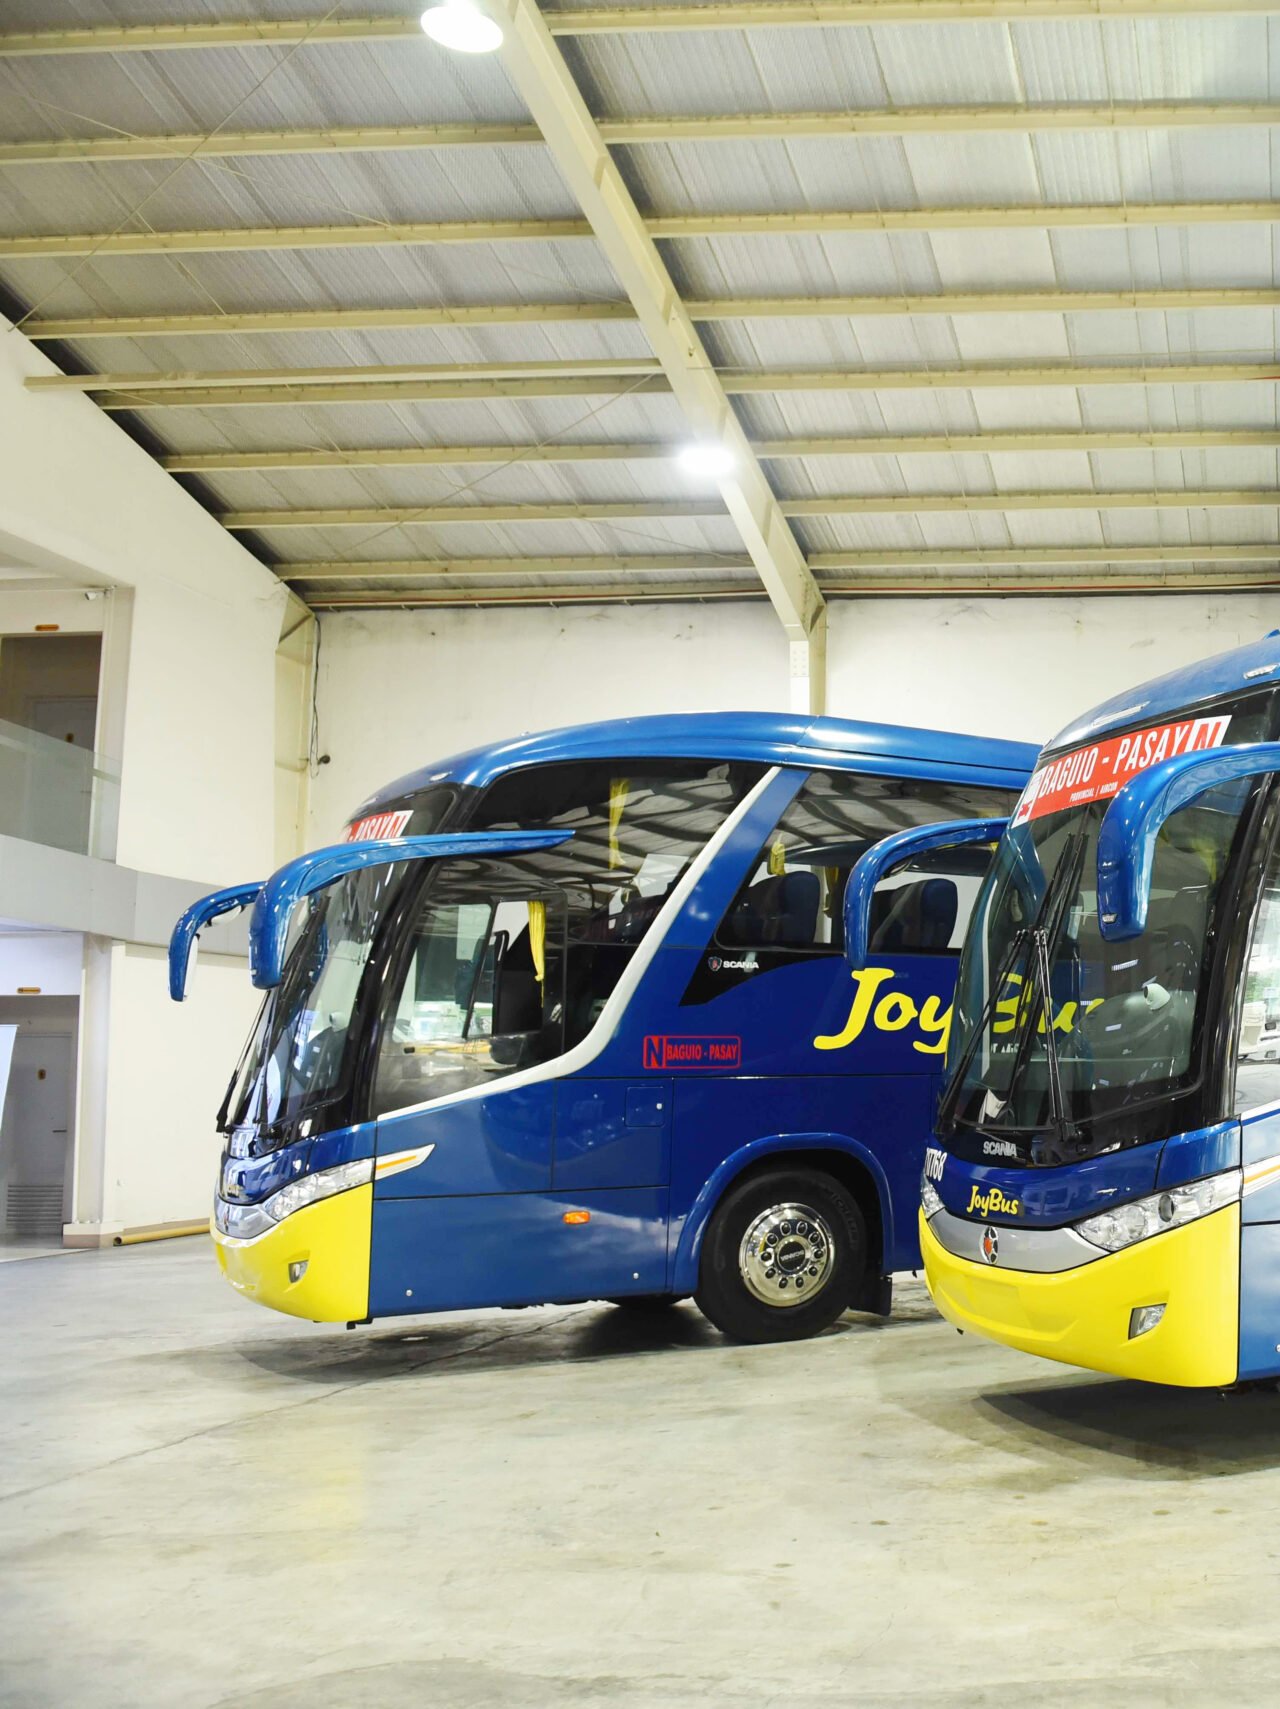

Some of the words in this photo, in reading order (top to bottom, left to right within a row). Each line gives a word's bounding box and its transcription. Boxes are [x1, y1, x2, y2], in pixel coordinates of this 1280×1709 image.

[1038, 747, 1099, 799] BAGUIO
[1112, 724, 1190, 775] PASAY
[1069, 787, 1095, 803] PROVINCIAL
[1100, 781, 1118, 794] AIRCON
[723, 960, 760, 969] SCANIA
[667, 1044, 702, 1060] BAGUIO
[709, 1044, 738, 1060] PASAY
[983, 1141, 1017, 1157] SCANIA
[966, 1185, 1019, 1217] JoyBus
